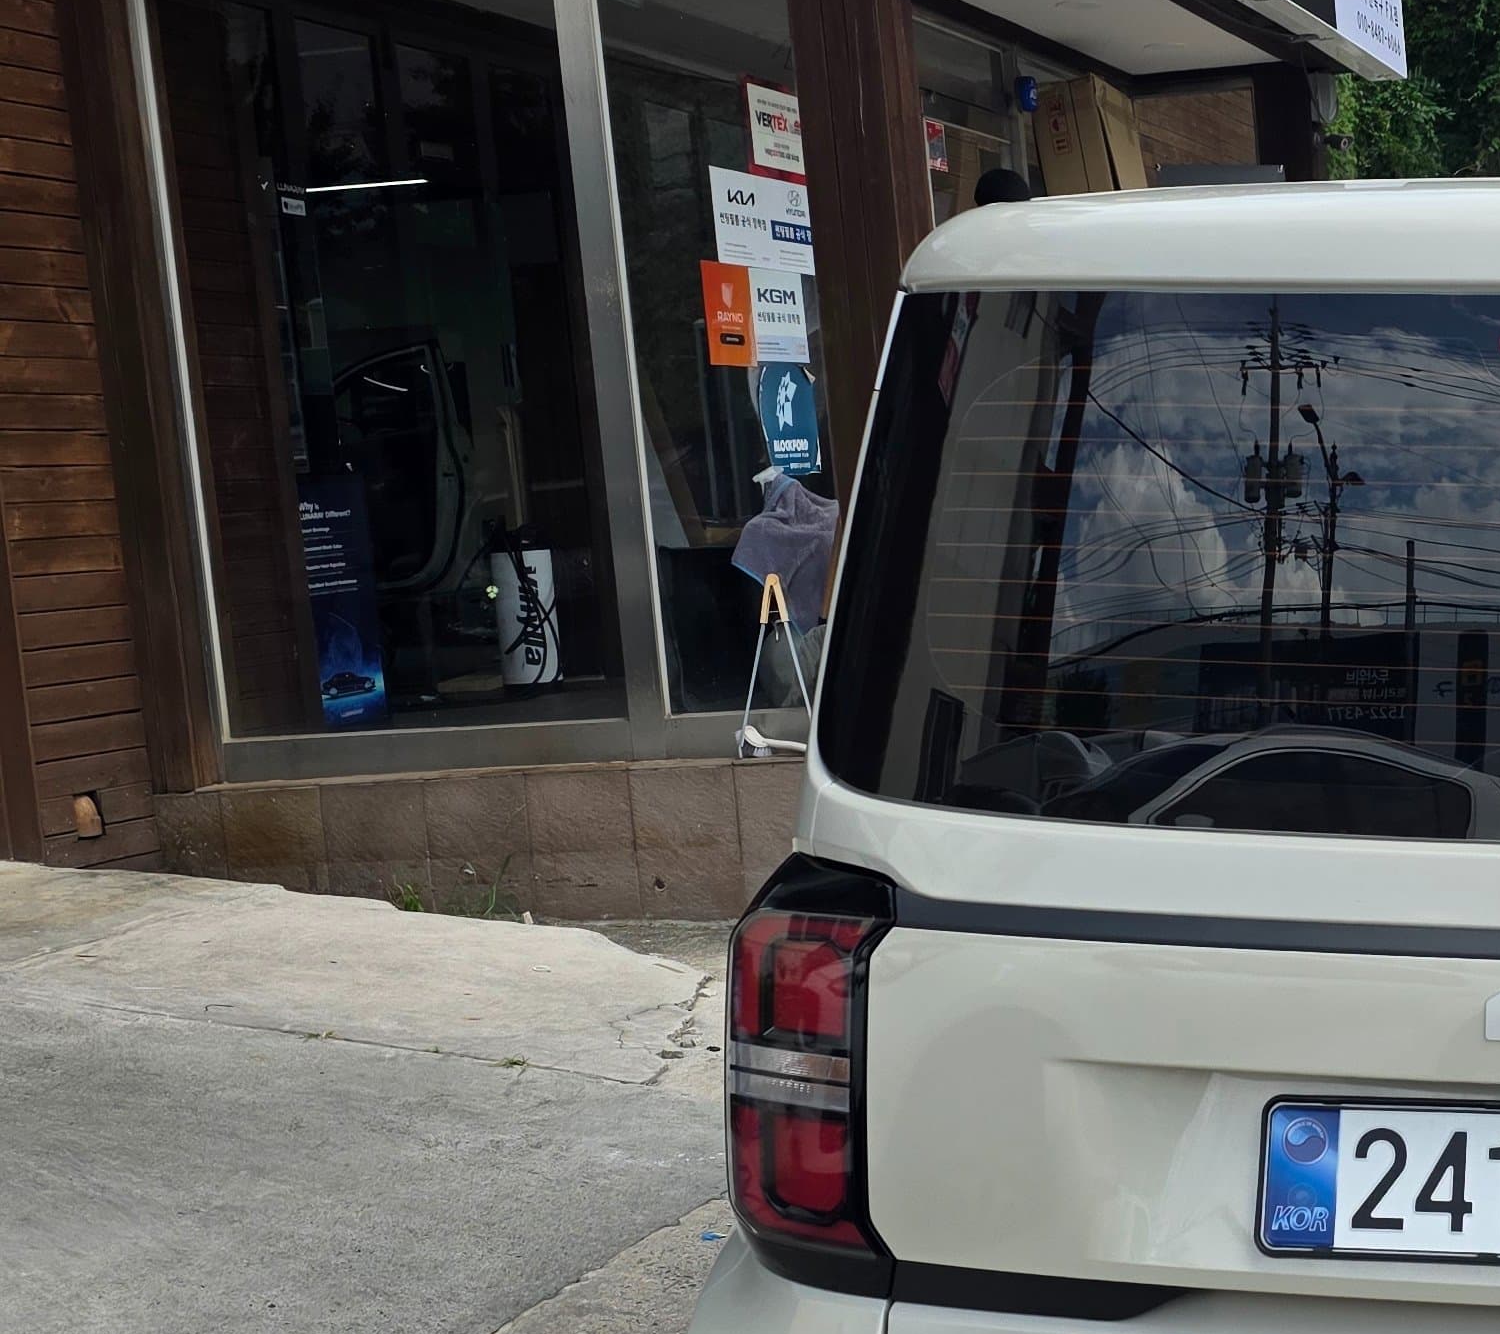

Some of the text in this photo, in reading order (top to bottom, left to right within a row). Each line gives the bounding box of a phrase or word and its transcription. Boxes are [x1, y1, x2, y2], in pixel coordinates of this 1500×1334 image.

[727, 187, 755, 207] KIA
[757, 287, 796, 305] KGM
[1271, 1205, 1329, 1233] KOR
